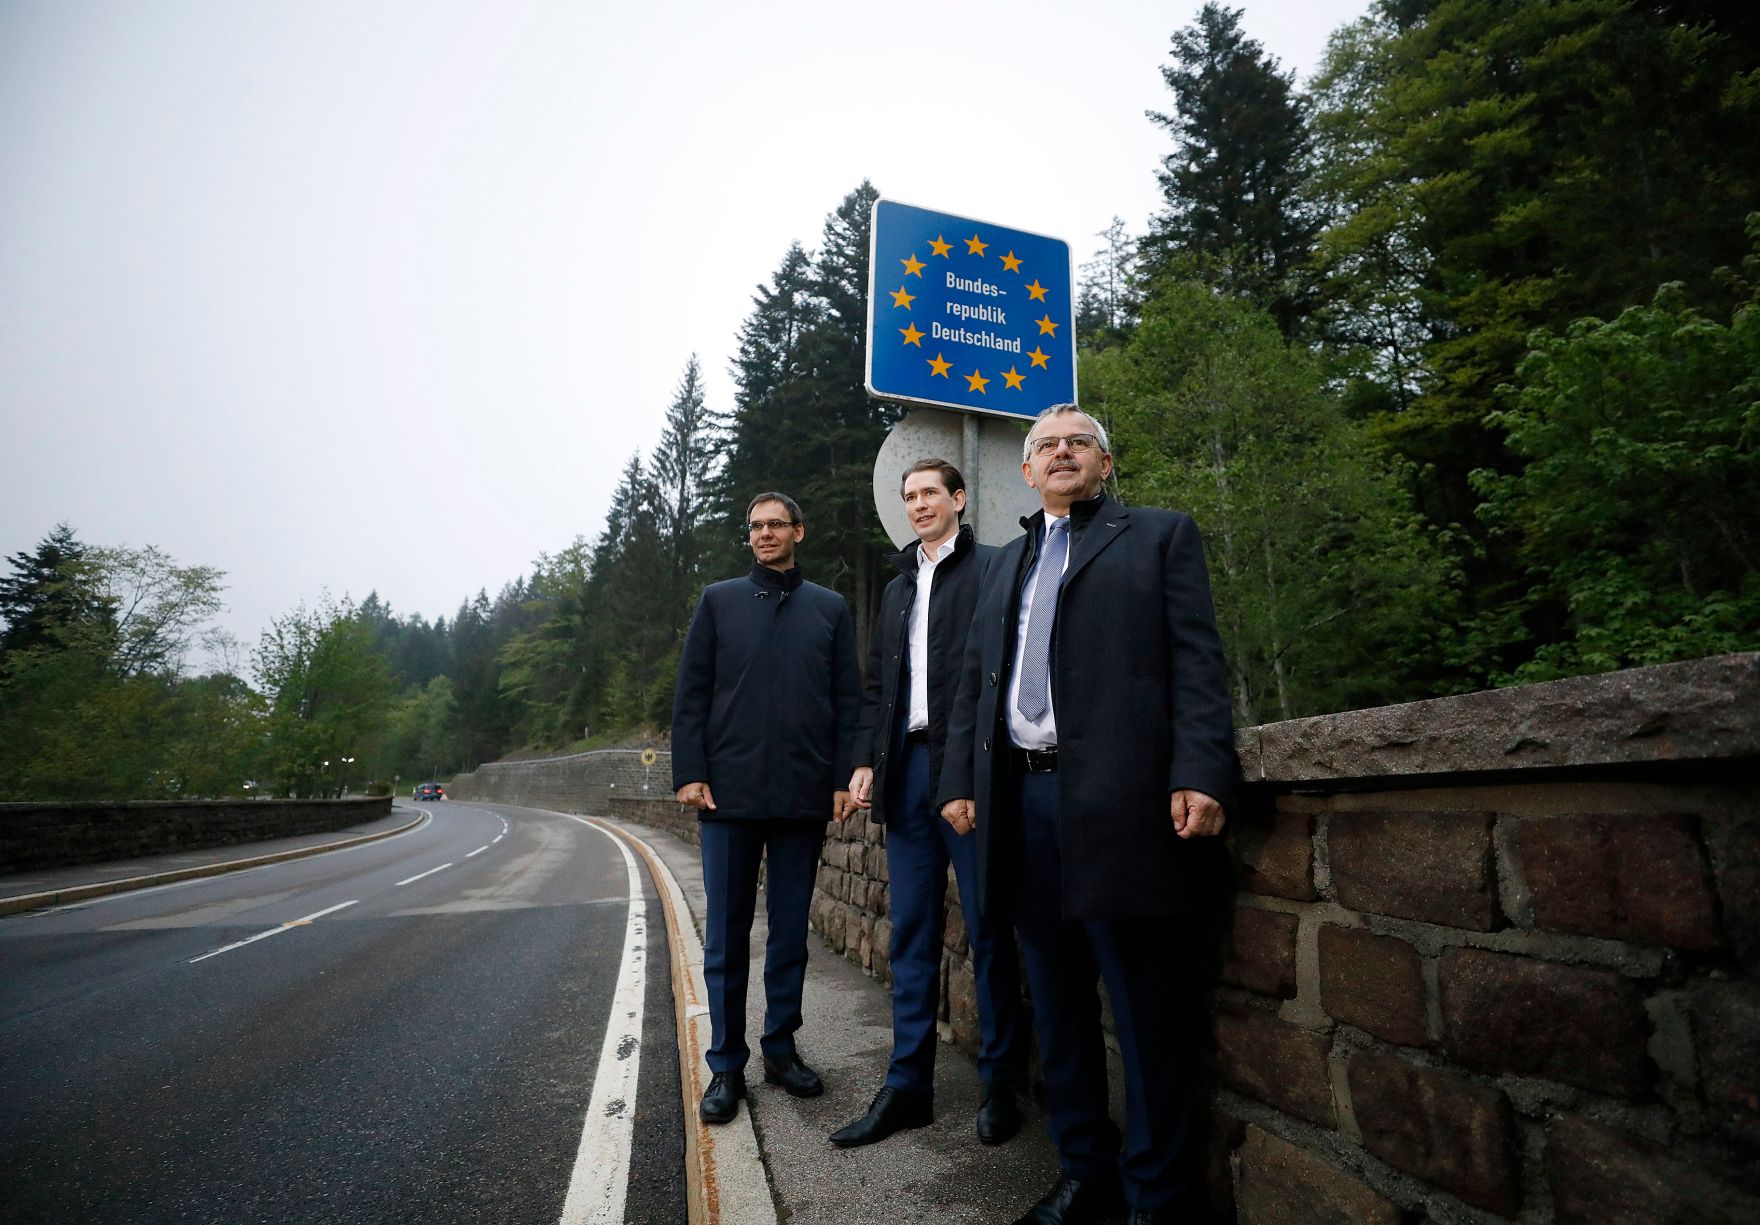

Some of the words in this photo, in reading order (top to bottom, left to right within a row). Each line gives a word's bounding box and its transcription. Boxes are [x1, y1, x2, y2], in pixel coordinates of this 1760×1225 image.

[946, 271, 1007, 297] Bundes-
[946, 301, 1007, 325] republik
[932, 321, 1021, 354] Deutschland
